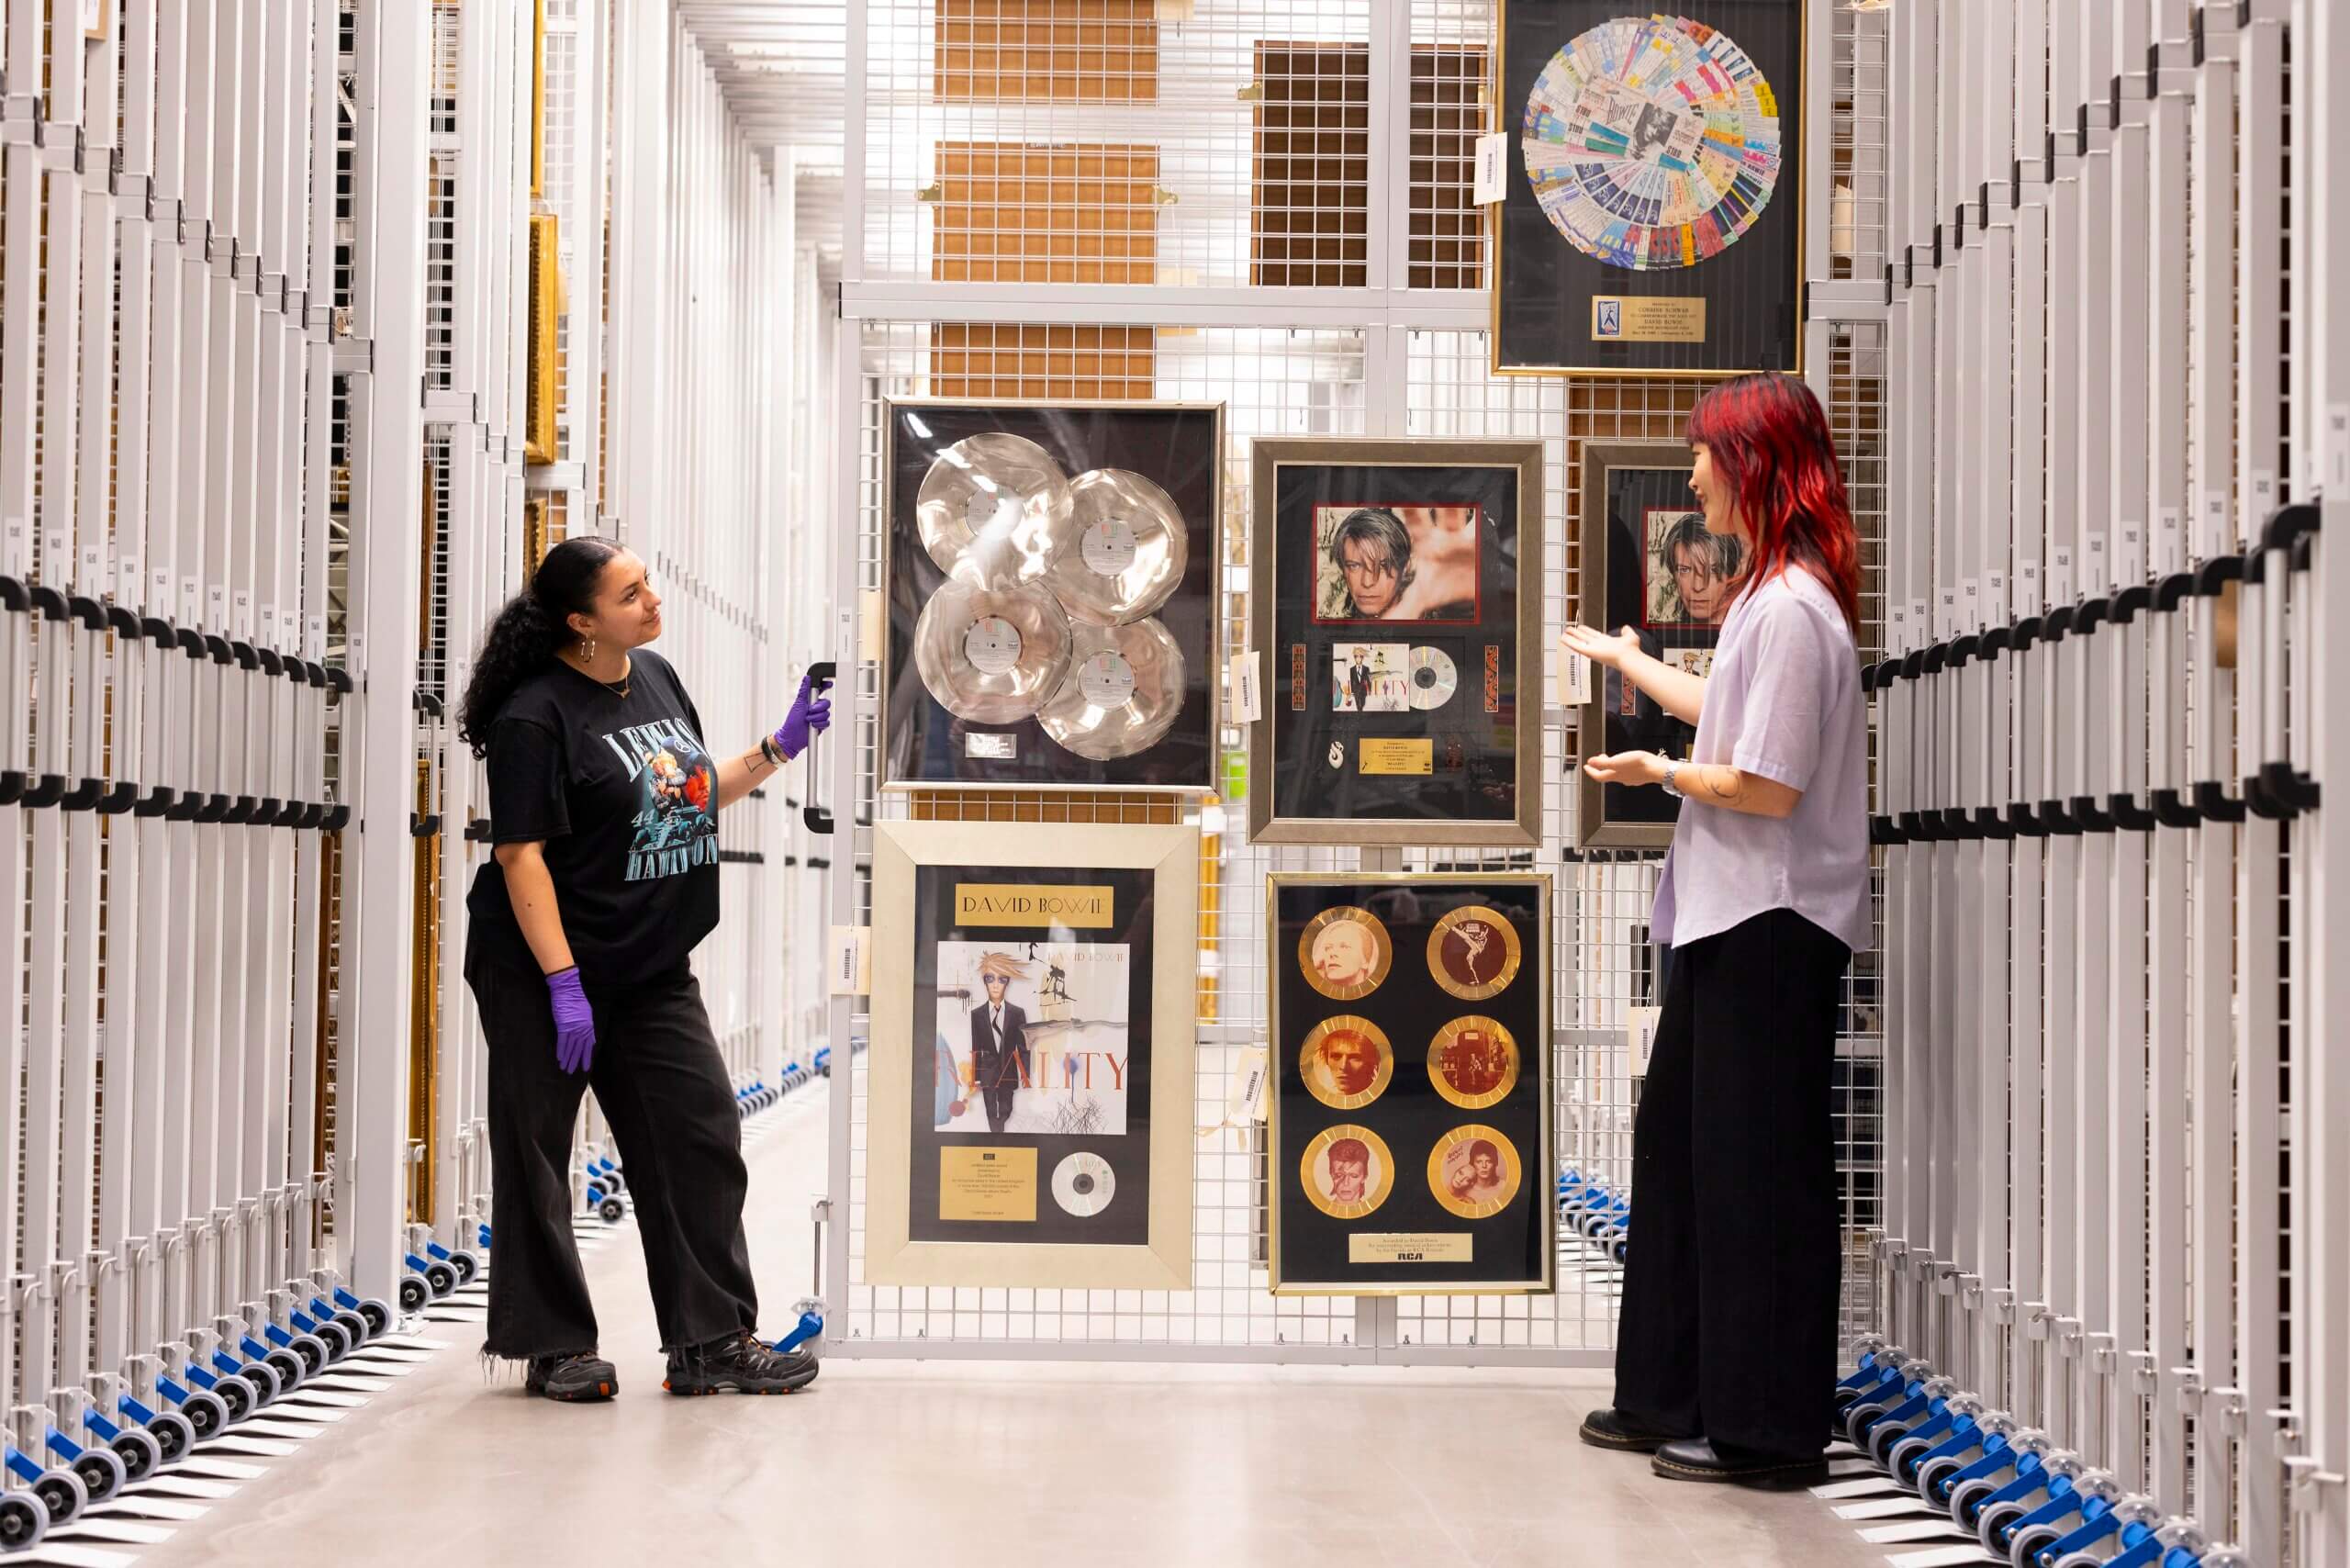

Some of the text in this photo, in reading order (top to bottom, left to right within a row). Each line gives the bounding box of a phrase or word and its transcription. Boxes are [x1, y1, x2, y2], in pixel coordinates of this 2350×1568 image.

[1606, 95, 1639, 125] BOWIE
[602, 718, 711, 783] LEWIS
[631, 811, 655, 827] 44
[963, 897, 1106, 914] DAVID BOWIE
[933, 1049, 1128, 1091] REALITY
[1397, 1252, 1423, 1260] RCA
